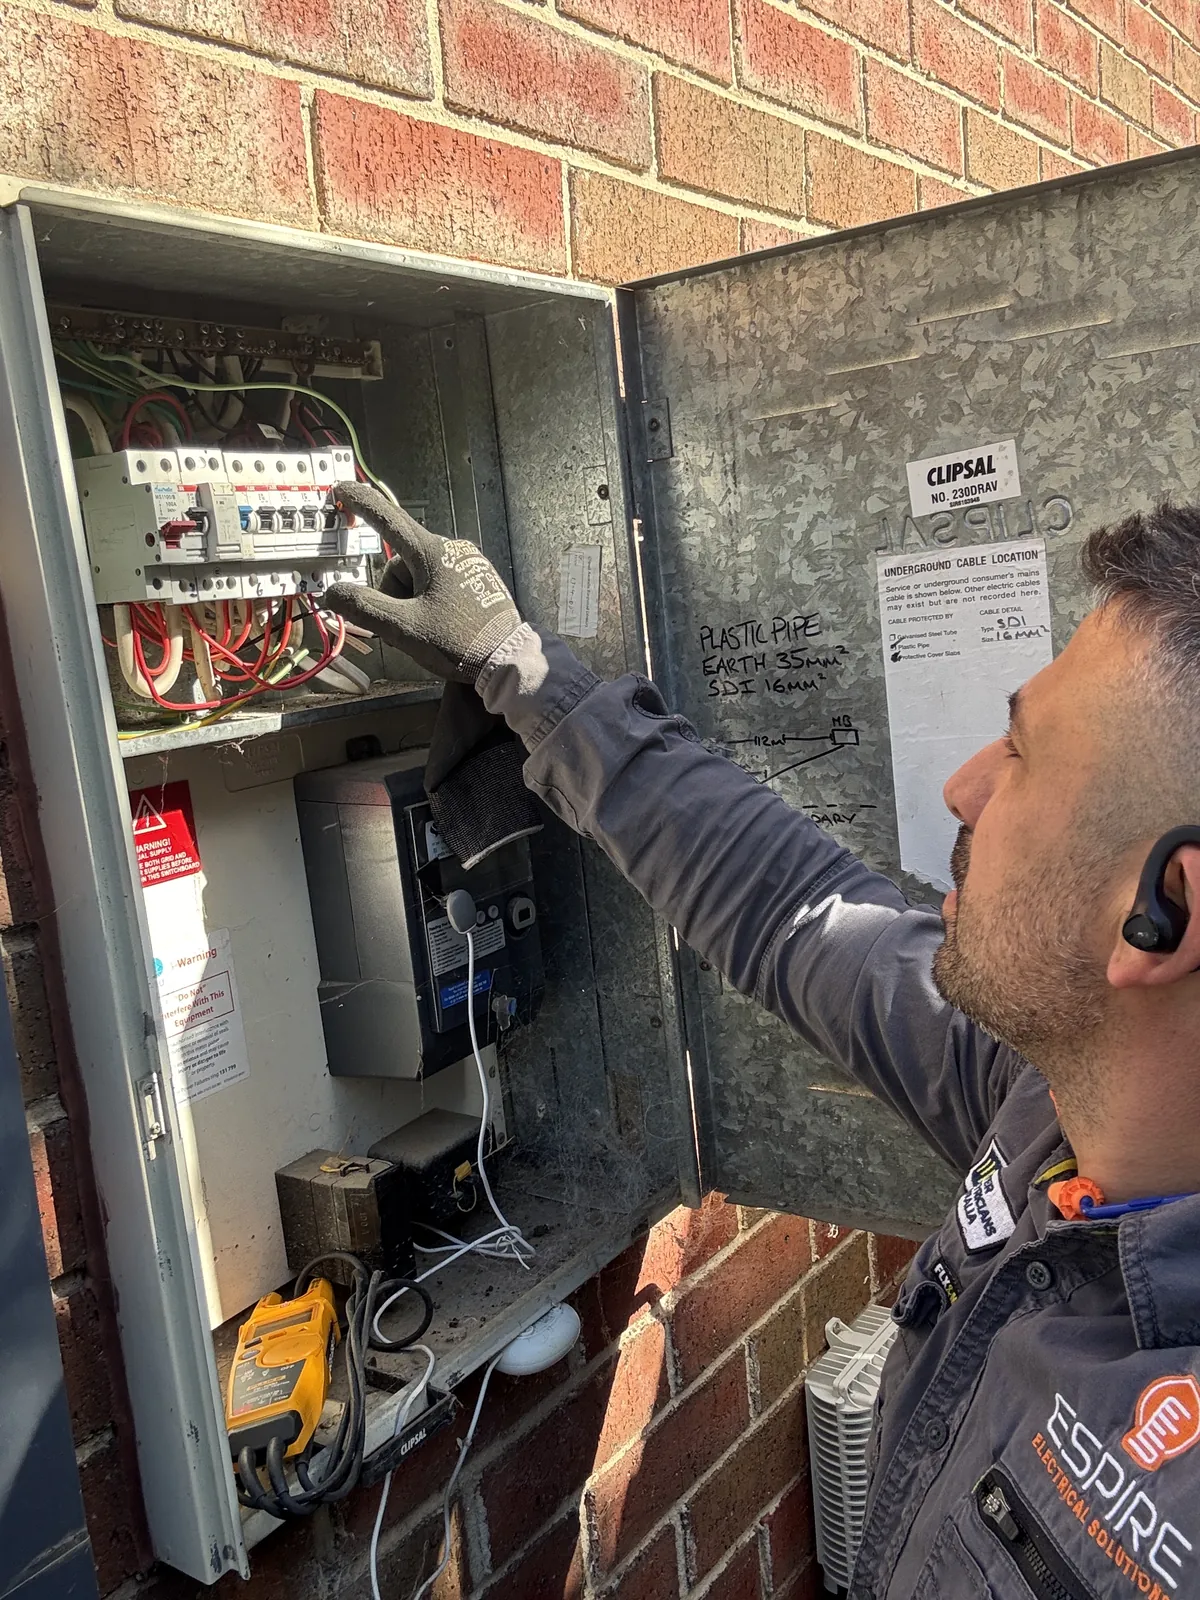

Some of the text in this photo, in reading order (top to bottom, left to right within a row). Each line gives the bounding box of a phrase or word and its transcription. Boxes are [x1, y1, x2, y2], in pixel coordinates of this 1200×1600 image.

[927, 455, 996, 486] CLIPSAL
[931, 480, 998, 504] NO. 230DRAV
[884, 550, 1038, 578] UNDERGROUND CABLE LOCATION
[885, 584, 911, 593] Service
[924, 577, 969, 589] underground
[972, 572, 1014, 583] consumer's
[1017, 570, 1040, 578] mains
[886, 594, 905, 602] cable
[914, 590, 938, 599] shown
[939, 587, 962, 596] below.
[964, 585, 985, 593] Other
[987, 581, 1014, 591] electric
[1016, 579, 1041, 589] cables
[887, 604, 902, 612] may
[906, 601, 924, 609] exist
[929, 599, 942, 607] but
[963, 596, 975, 604] not
[980, 592, 1016, 602] recorded
[1021, 588, 1041, 597] here.
[908, 614, 944, 623] PROTECTED
[979, 606, 1023, 616] CABLE DETAIL
[700, 612, 822, 653] PLASTIC PIPE
[897, 633, 928, 641] Galvanised
[918, 642, 930, 650] Pipe
[702, 653, 766, 676] EARTH
[708, 679, 756, 696] SDI
[811, 813, 856, 826] DARY
[136, 838, 171, 854] ARNING!
[149, 846, 172, 858] SUPPLY
[144, 859, 160, 868] BOTH
[161, 855, 174, 863] GRID
[175, 851, 187, 860] AND
[144, 863, 170, 875] SUPPLIES
[171, 856, 193, 868] BEFORE
[147, 872, 160, 880] THIS
[161, 861, 200, 878] SWITCHBOARD
[177, 948, 217, 968] Warning
[192, 996, 209, 1008] With
[210, 990, 225, 1002] This
[174, 1006, 214, 1028] Equipment
[400, 1427, 427, 1456] CLIPSAL
[1031, 1432, 1090, 1524] ELECTRICAL
[1047, 1393, 1192, 1589] ESPIRE
